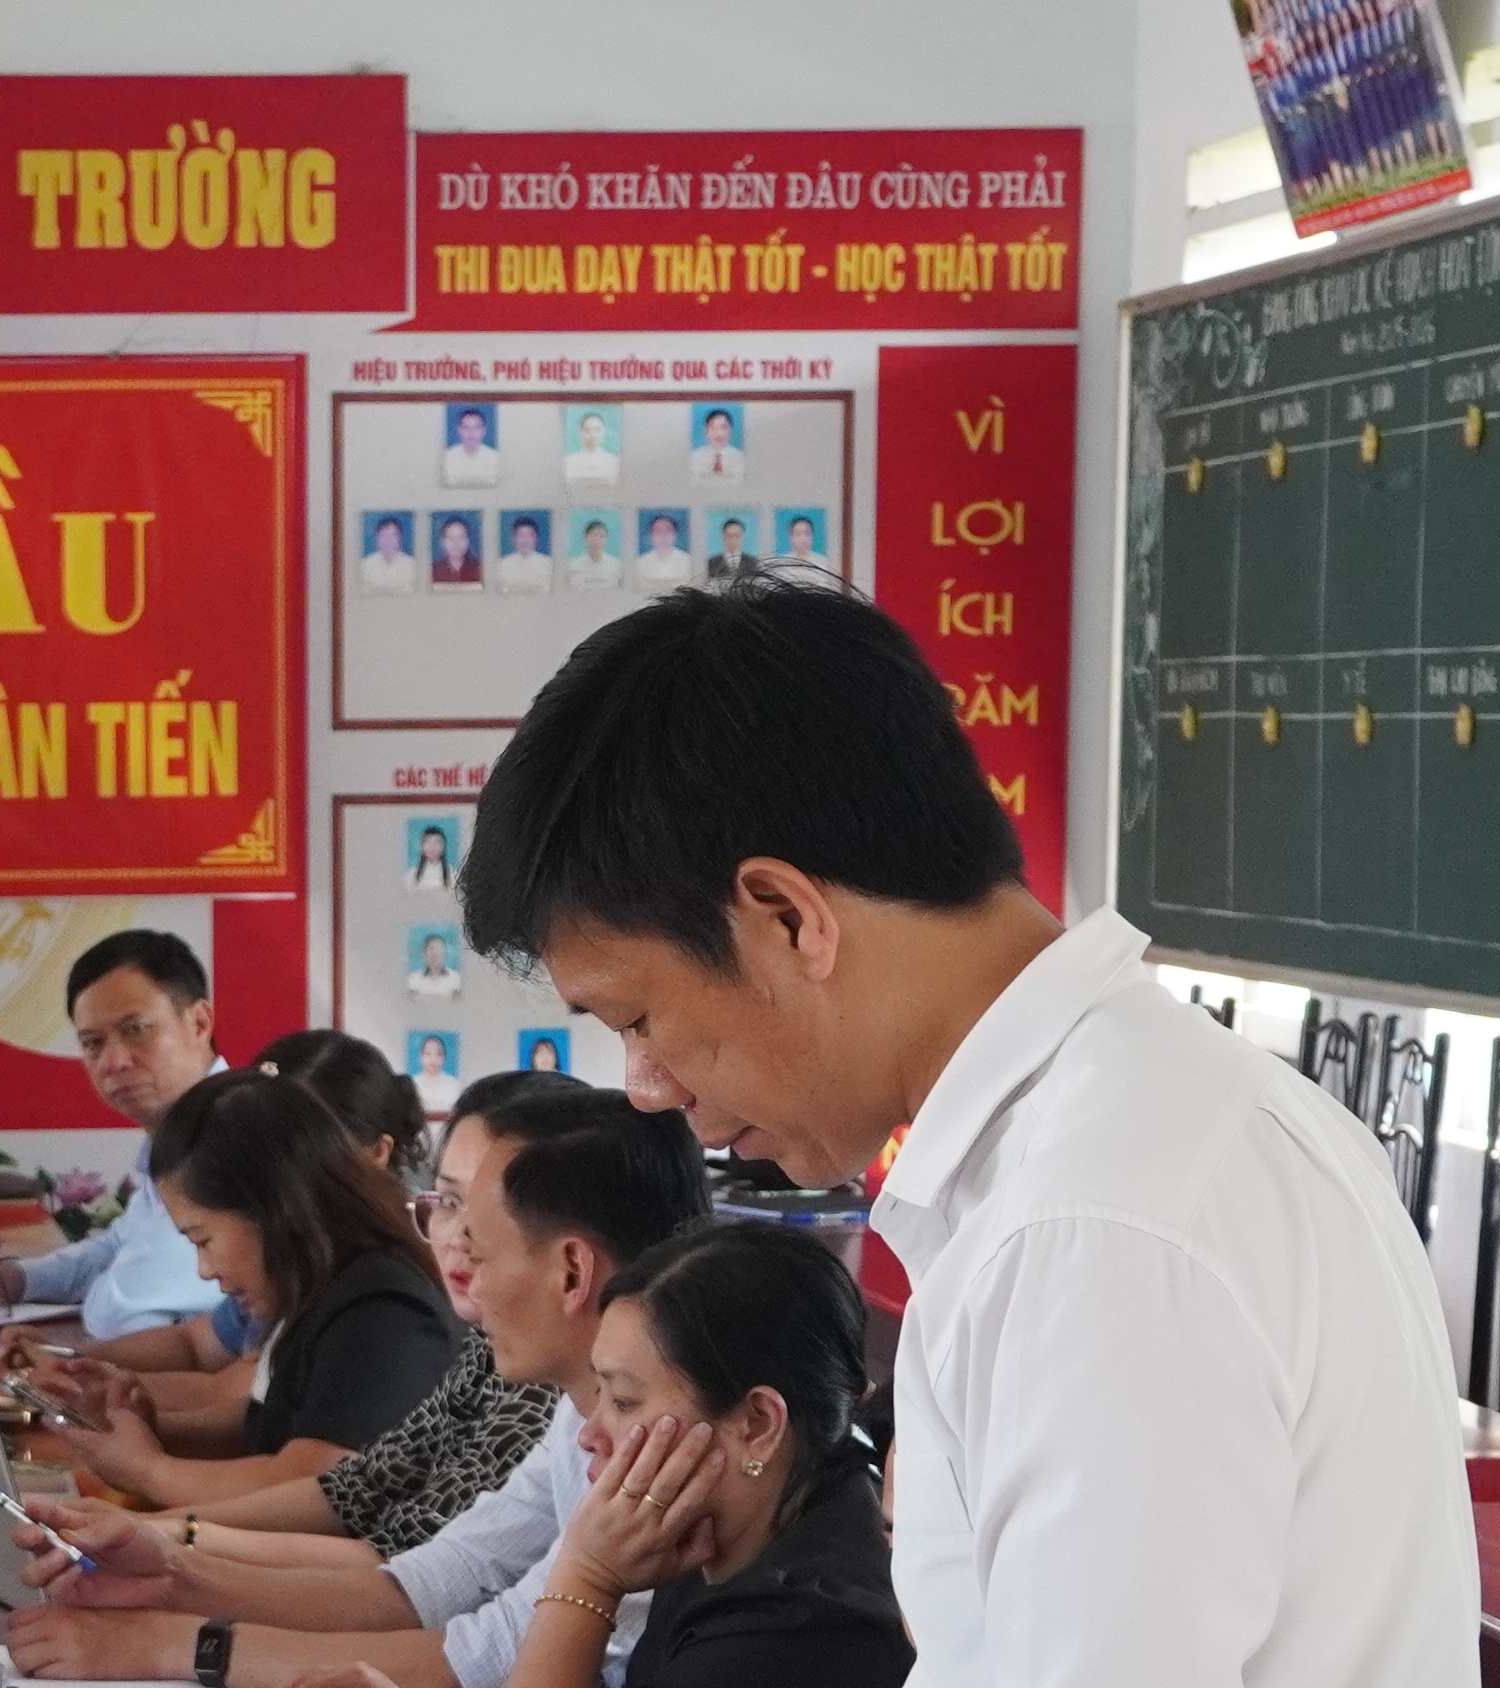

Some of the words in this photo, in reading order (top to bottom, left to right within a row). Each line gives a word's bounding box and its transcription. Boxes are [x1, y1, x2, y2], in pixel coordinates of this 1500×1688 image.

[19, 118, 338, 252] TRƯỜNG
[438, 162, 492, 213] DÙ
[499, 162, 581, 212] KHÓ
[588, 164, 694, 212] KHĂN
[700, 154, 779, 211] ĐẾN
[785, 159, 865, 211] ĐÂU
[869, 163, 973, 211] CŨNG
[978, 154, 1068, 210] PHẢI
[435, 243, 492, 296] THI
[498, 245, 569, 296] ĐUA
[574, 244, 645, 306] DẠY
[651, 234, 738, 306] THẬT
[742, 227, 808, 296] TỐT
[836, 243, 908, 305] HỌC
[913, 232, 1001, 304] THẬT
[1005, 225, 1070, 294] TỐT
[353, 357, 397, 385] HIỆU
[493, 357, 532, 381] PHÓ
[538, 356, 582, 384] HIỆU
[672, 360, 709, 382] QUA
[716, 355, 752, 381] CÁC
[956, 395, 1007, 455] VÌ
[931, 496, 1027, 557] LỢI
[938, 577, 1016, 638] ÍCH
[86, 667, 241, 800] TIẾN
